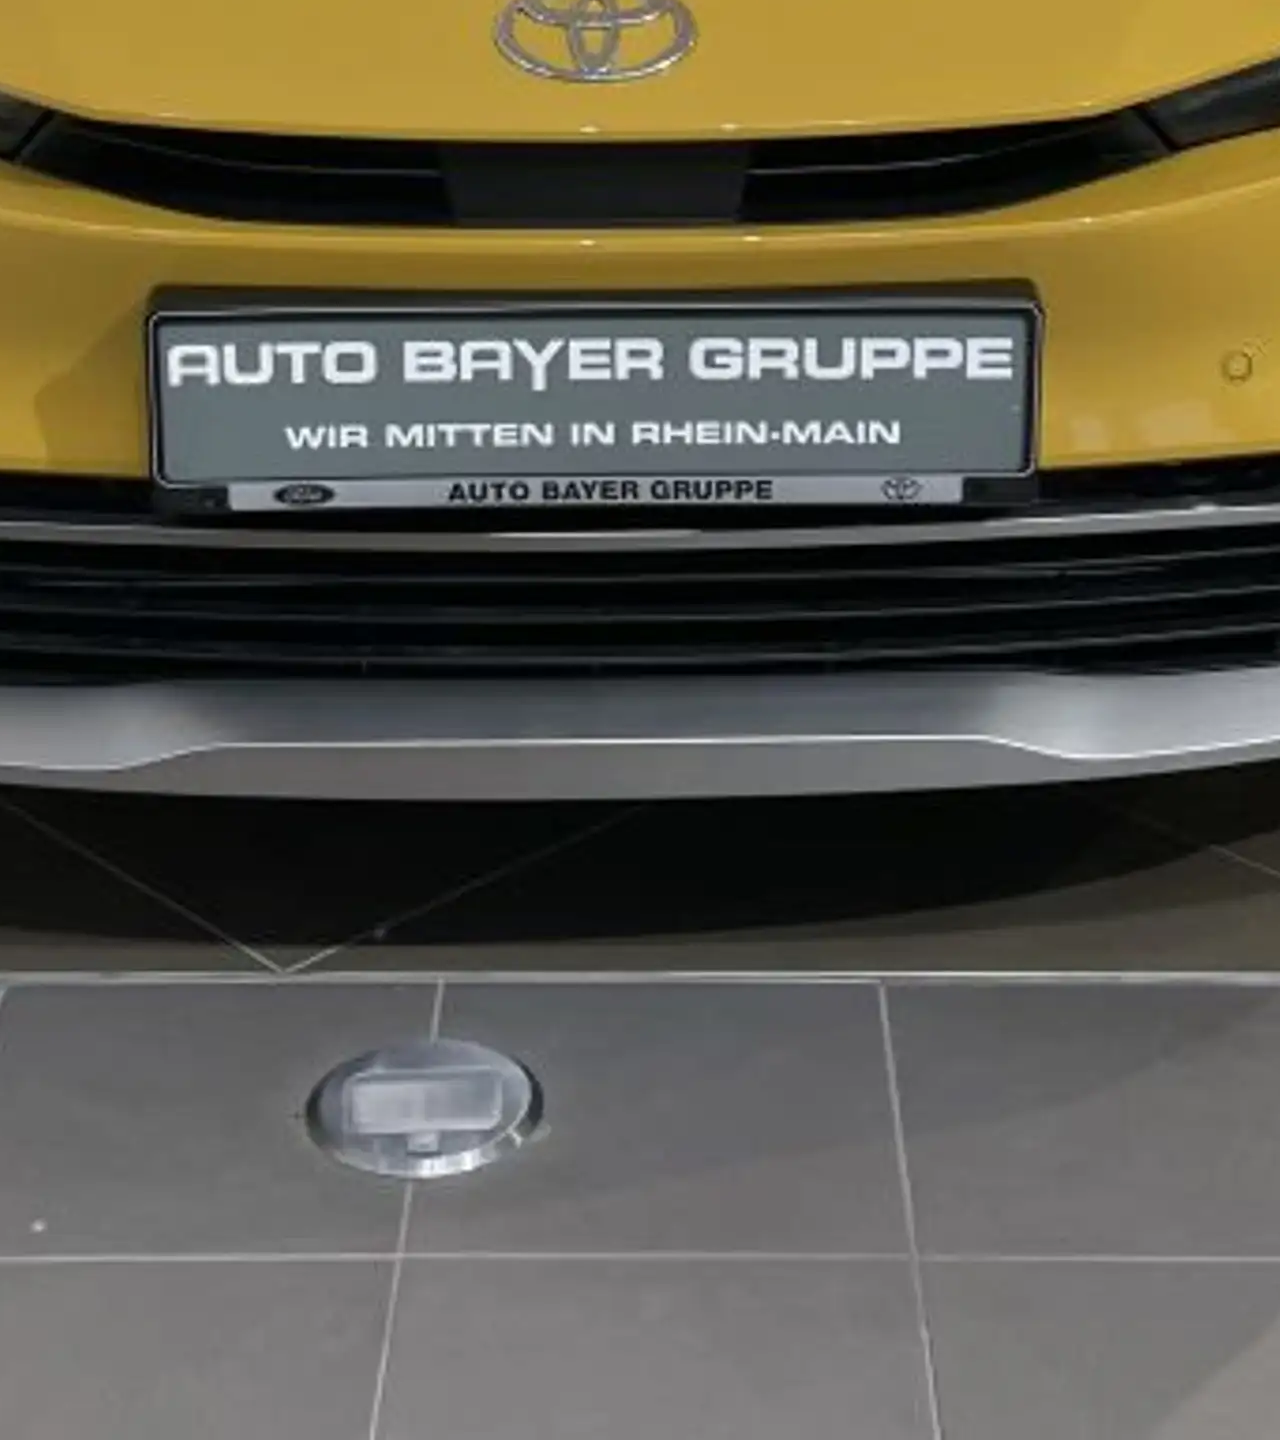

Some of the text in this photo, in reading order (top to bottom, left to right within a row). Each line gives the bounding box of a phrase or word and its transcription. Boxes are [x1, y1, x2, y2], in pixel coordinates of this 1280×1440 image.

[166, 336, 1014, 392] AUTO BAYER GRUPPE
[284, 418, 902, 451] WIR MITTEN IN RHEIN-MAIN
[447, 478, 774, 504] AUTO BAYER GRUPPE
